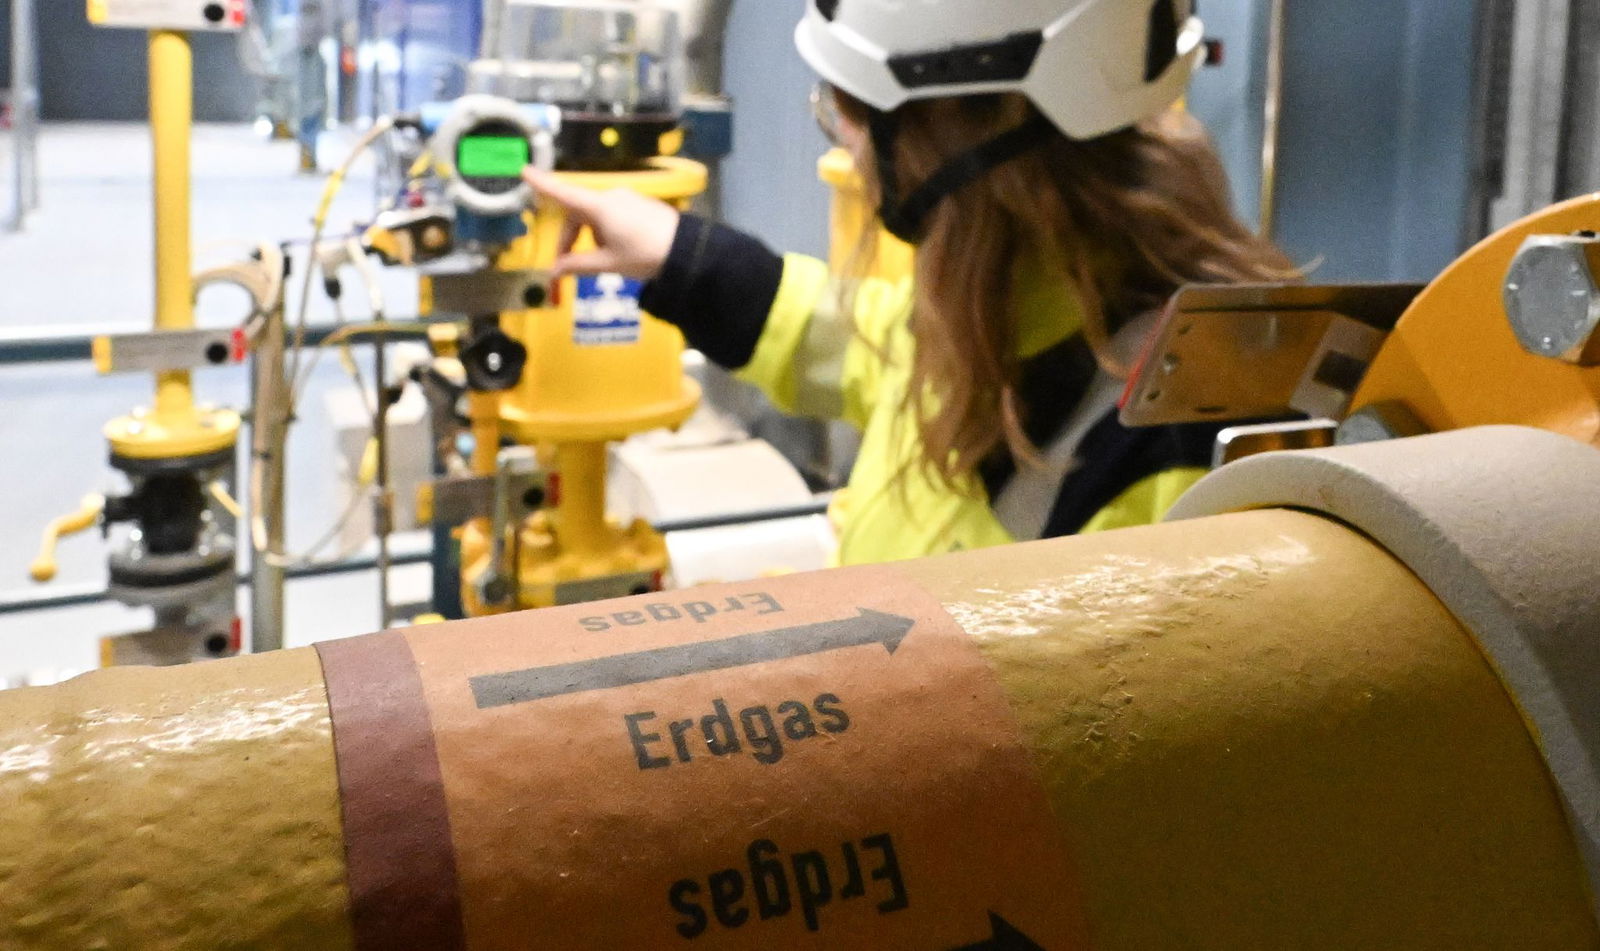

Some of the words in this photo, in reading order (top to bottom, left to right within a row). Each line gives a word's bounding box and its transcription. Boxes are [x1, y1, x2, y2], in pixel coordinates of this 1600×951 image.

[579, 592, 784, 631] Erdgas
[624, 693, 850, 770] Erdgas
[668, 833, 908, 939] Erdgas
